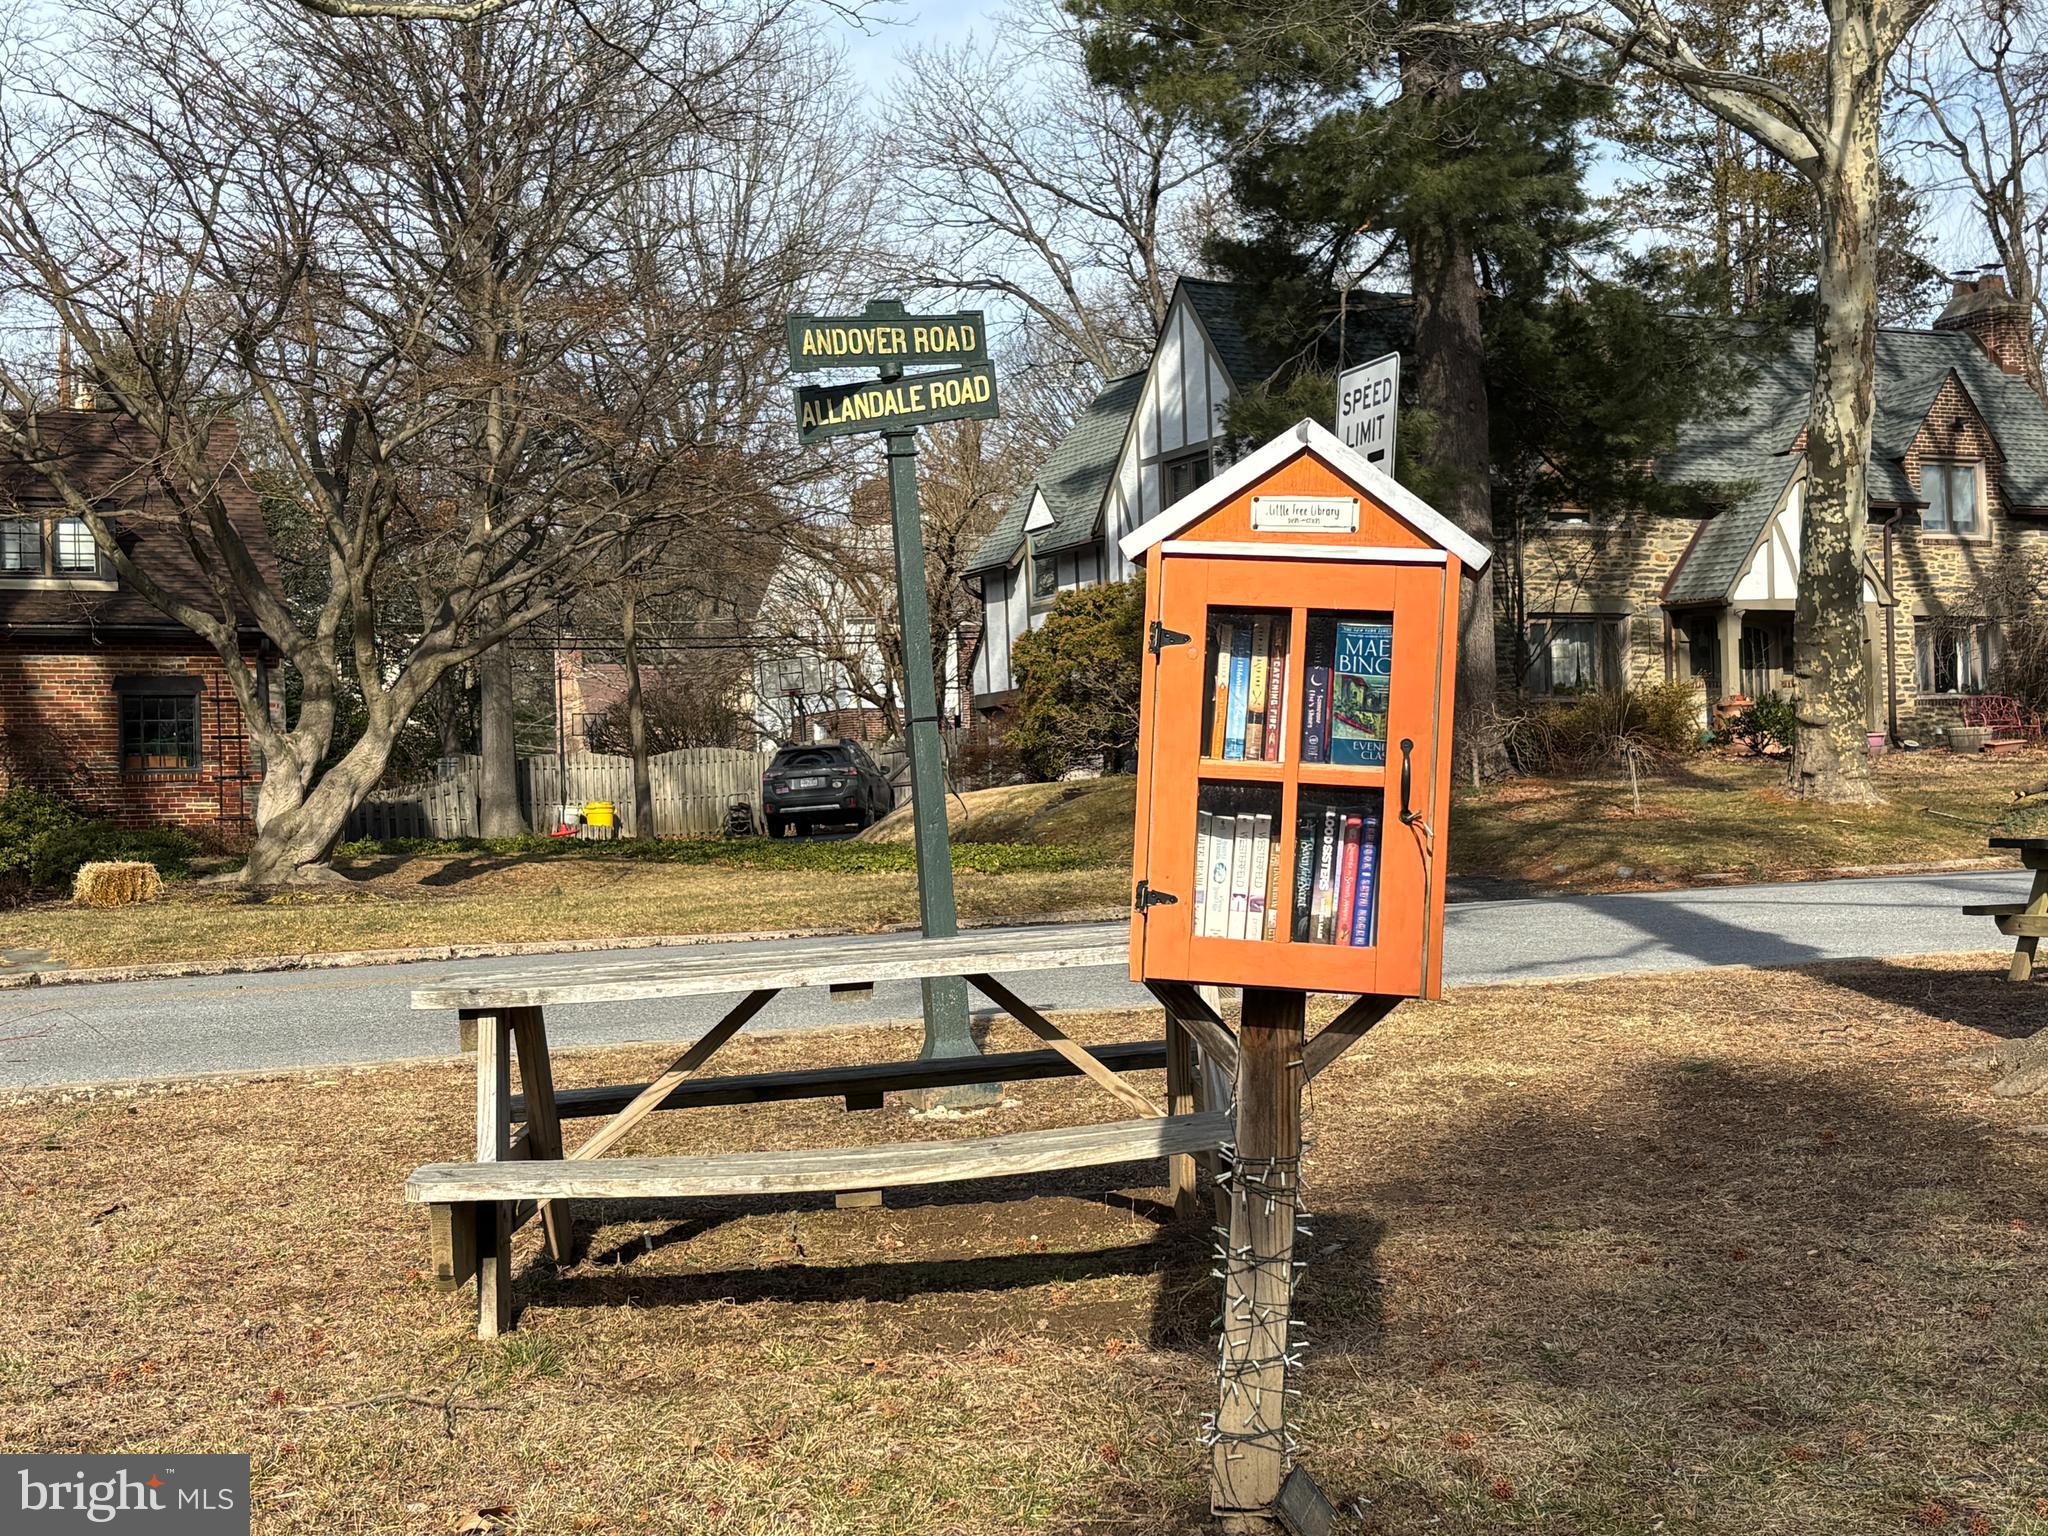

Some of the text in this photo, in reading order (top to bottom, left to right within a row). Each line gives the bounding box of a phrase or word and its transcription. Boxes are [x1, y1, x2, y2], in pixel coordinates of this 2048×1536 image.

[802, 325, 977, 356] ANDOVER ROAD
[802, 375, 991, 428] ALLANDALE ROAD
[1342, 377, 1392, 416] SPEED
[1346, 414, 1385, 448] LIMIT
[1269, 504, 1340, 520] Little Free Library
[1346, 637, 1390, 657] MAE
[1270, 660, 1282, 706] CATCHING
[1268, 708, 1279, 730] FIRE
[1323, 806, 1336, 844] BLOOD
[1319, 844, 1333, 891] SISTERS
[1297, 881, 1311, 908] Secret
